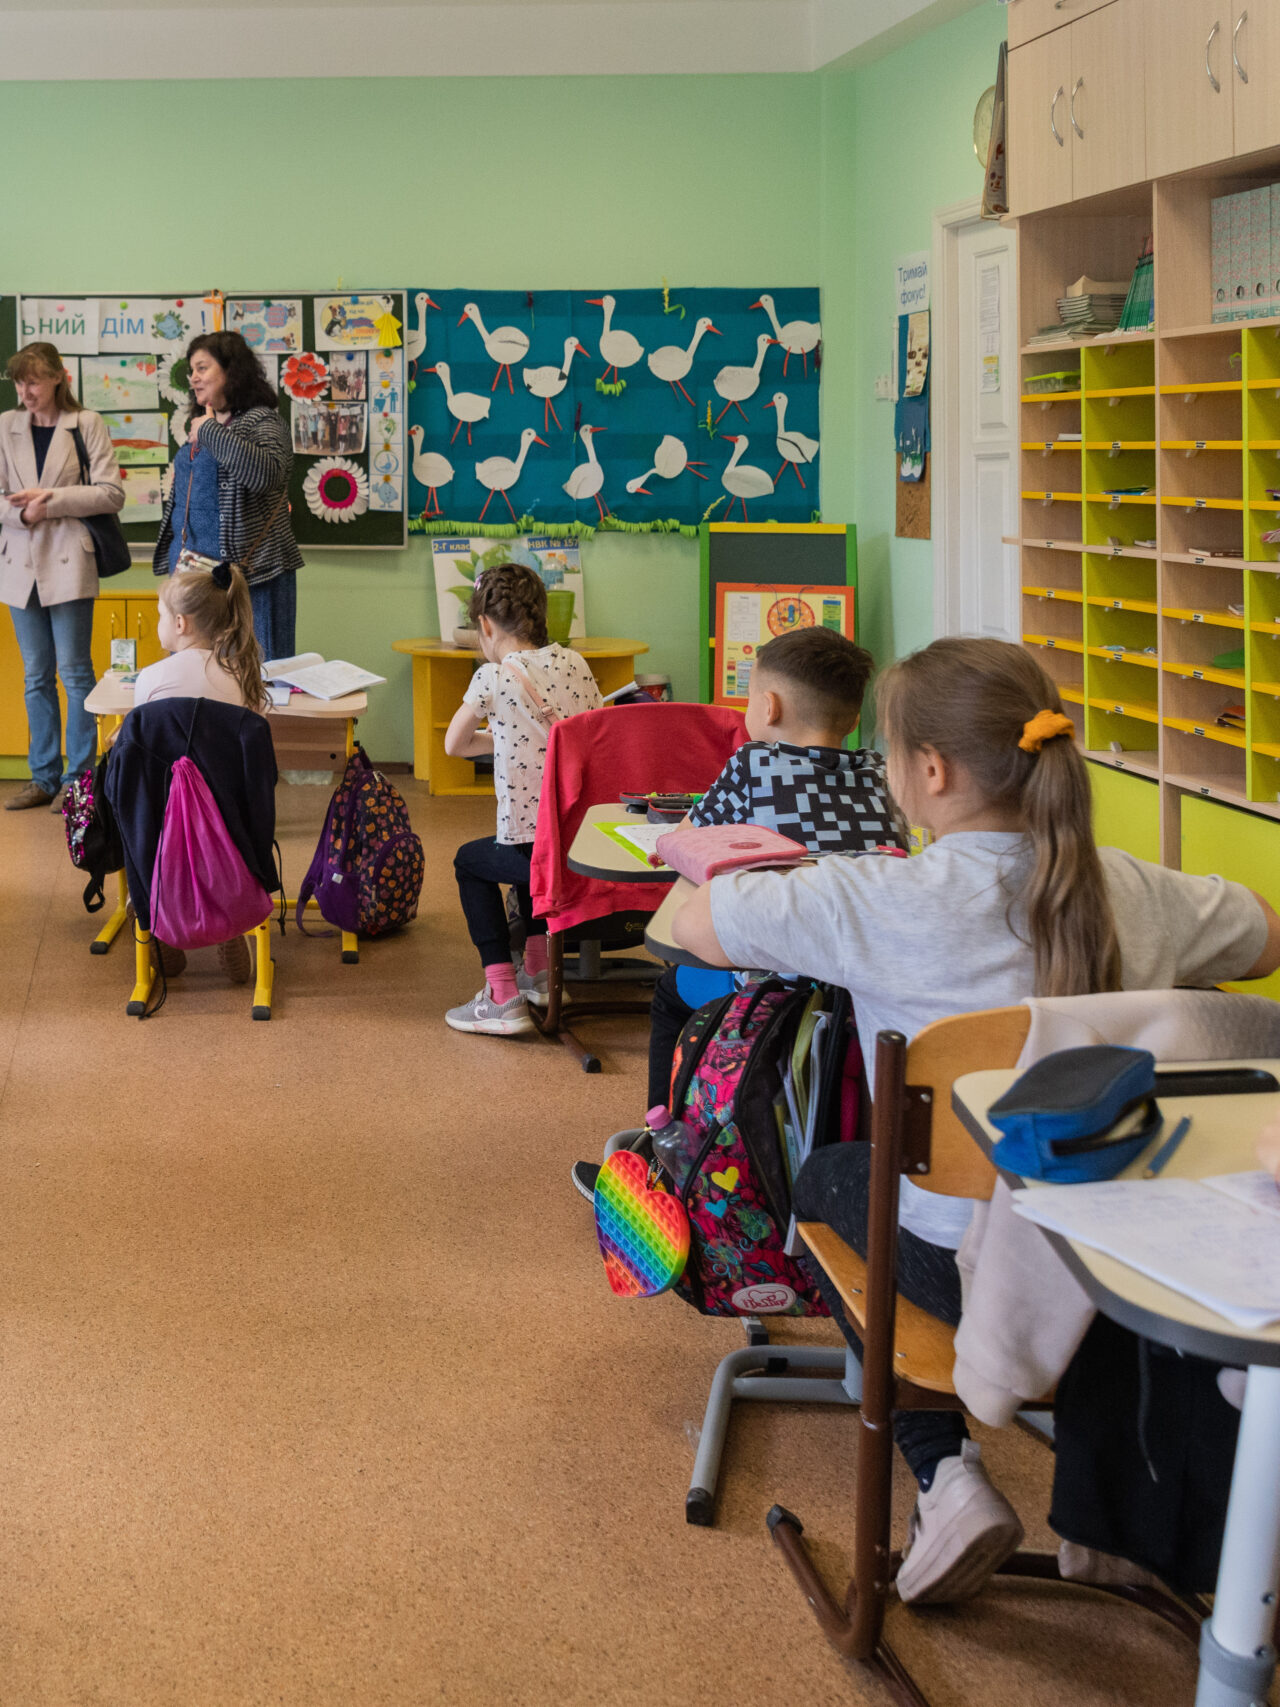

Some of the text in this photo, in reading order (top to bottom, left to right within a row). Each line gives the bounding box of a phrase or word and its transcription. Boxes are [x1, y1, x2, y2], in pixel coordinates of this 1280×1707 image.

[897, 261, 928, 286] Тримай
[900, 283, 926, 307] фокус!
[101, 312, 145, 339] дім
[449, 543, 471, 552] клас
[528, 539, 548, 549] НВК
